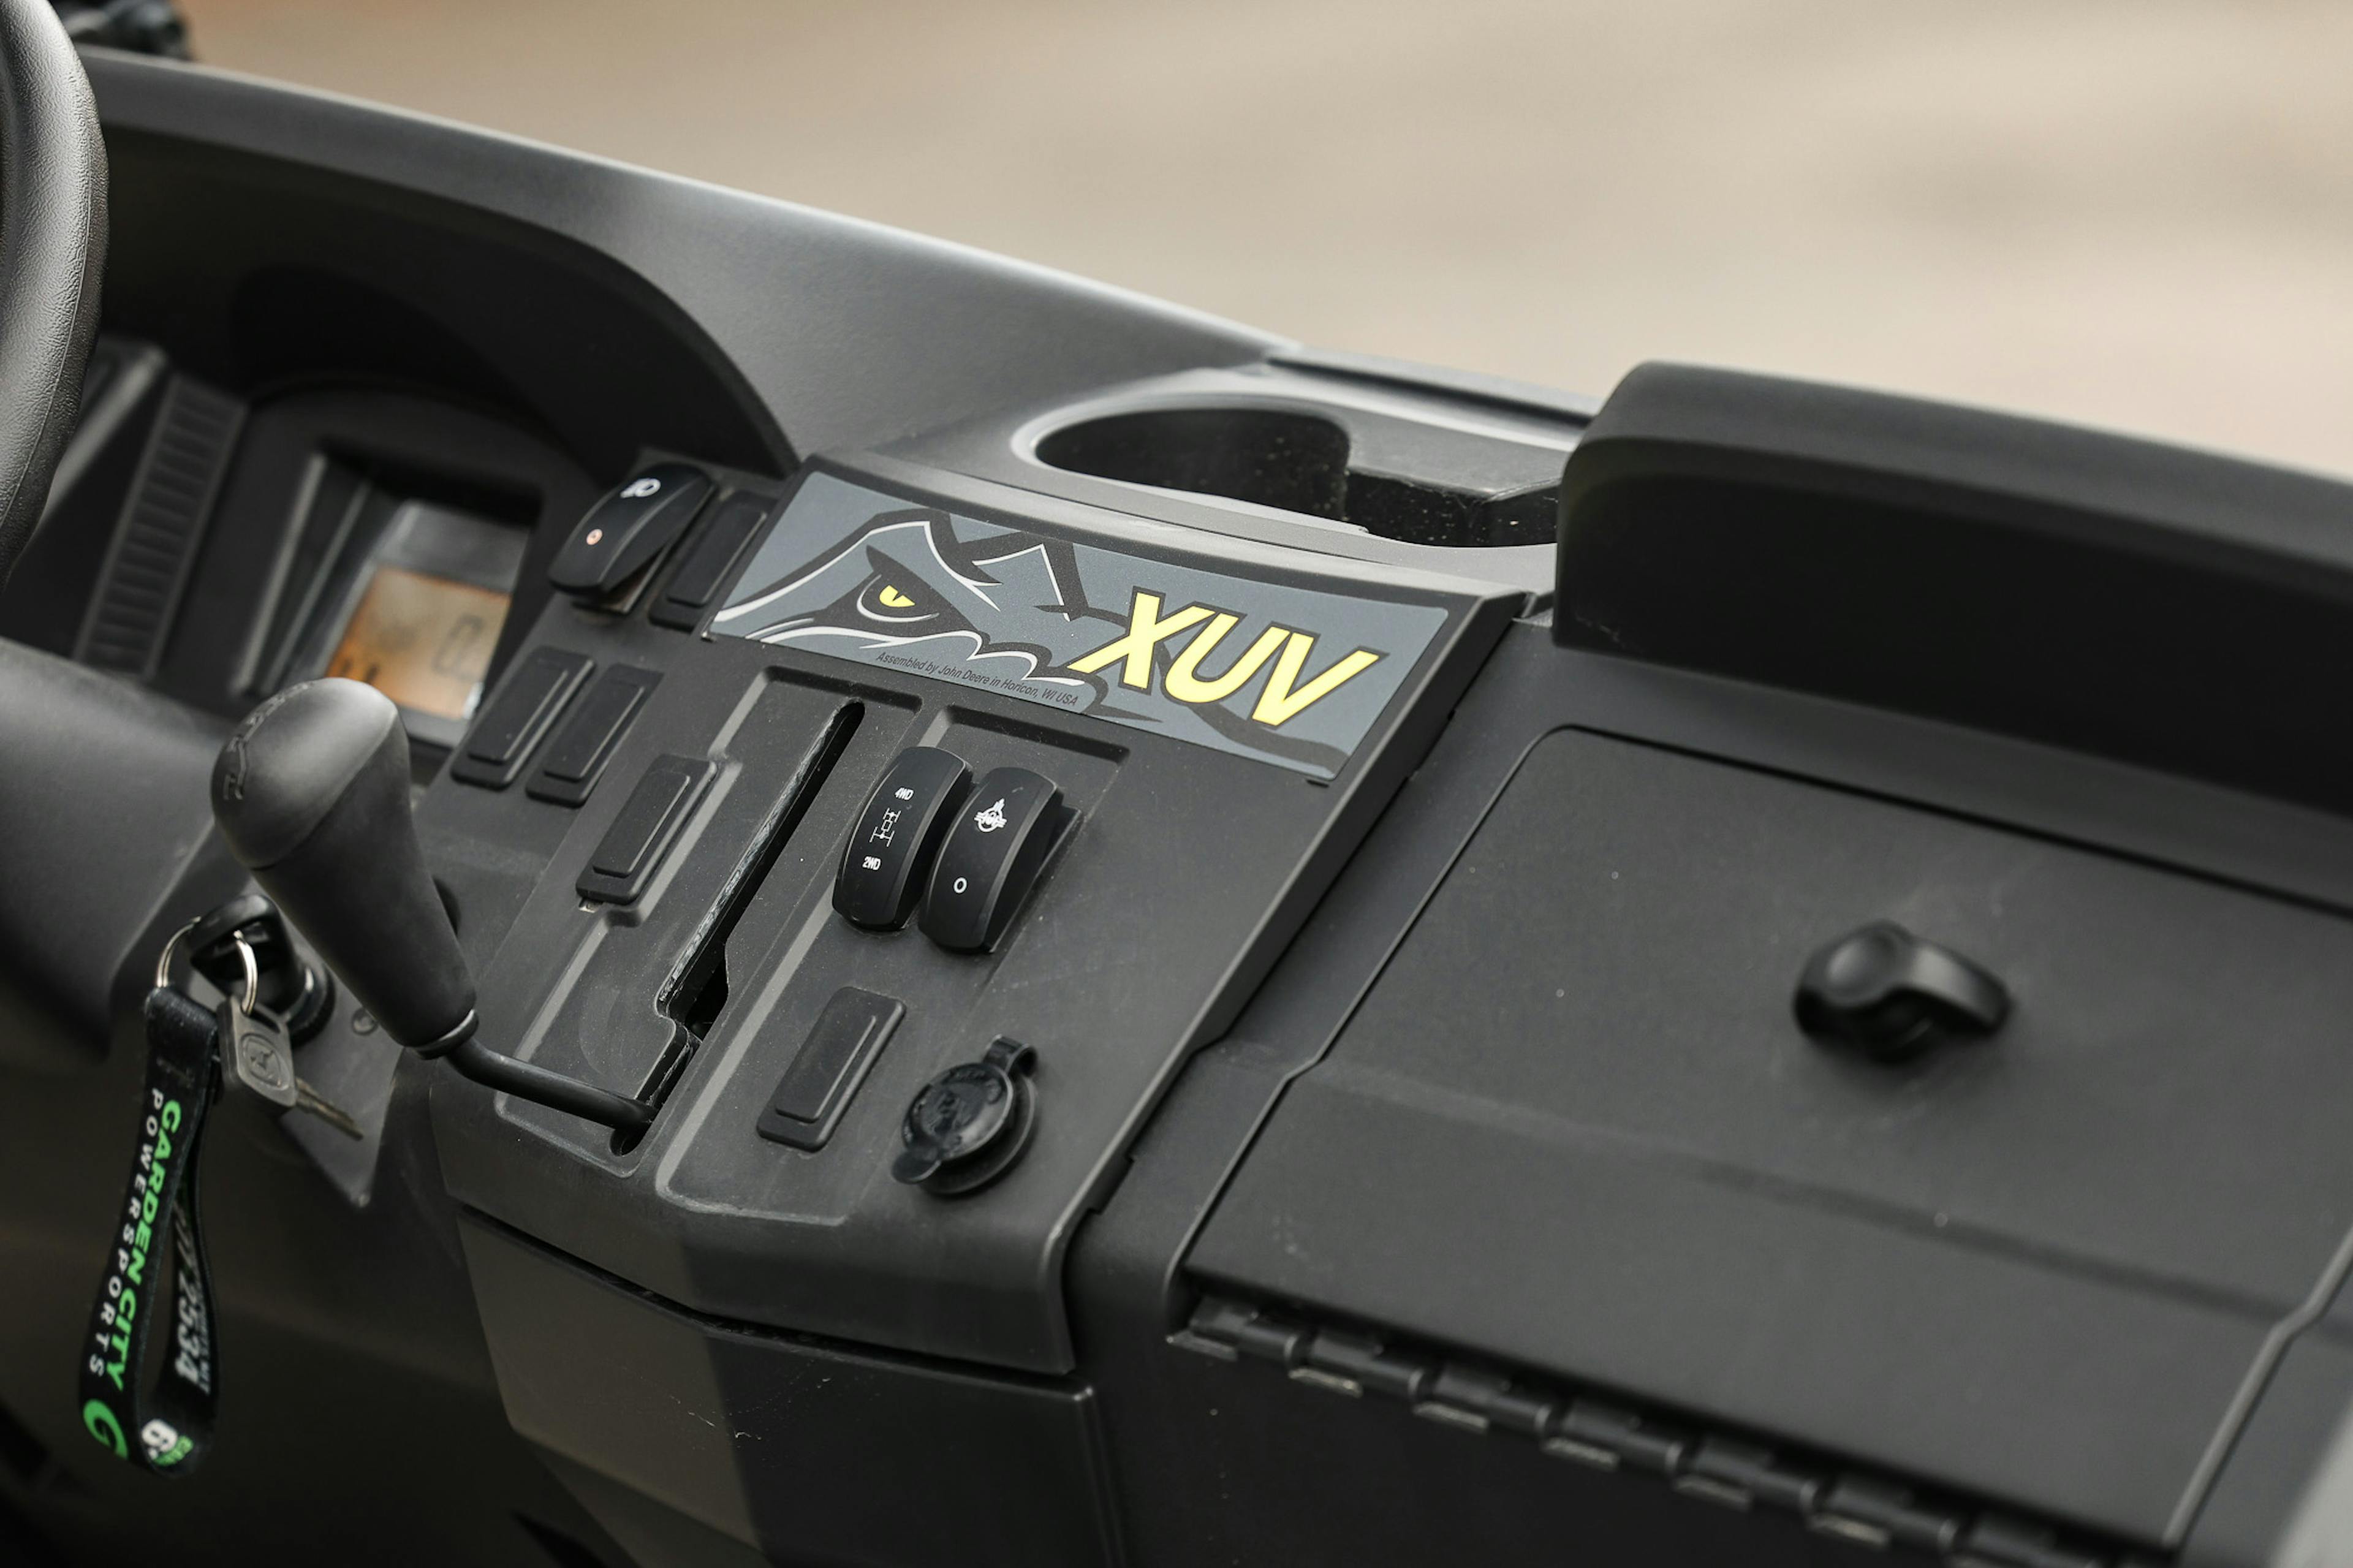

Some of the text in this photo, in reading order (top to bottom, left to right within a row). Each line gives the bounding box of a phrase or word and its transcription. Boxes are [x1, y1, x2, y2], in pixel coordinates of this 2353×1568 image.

[876, 652, 1079, 706] Assembled by John Deere in Horicon, WI USA
[1066, 591, 1379, 726] XUV
[895, 787, 914, 800] 4WD
[862, 855, 881, 871] 2WD
[89, 1088, 164, 1377] POWERSPORTS
[107, 1100, 181, 1392] GARDEN CITY
